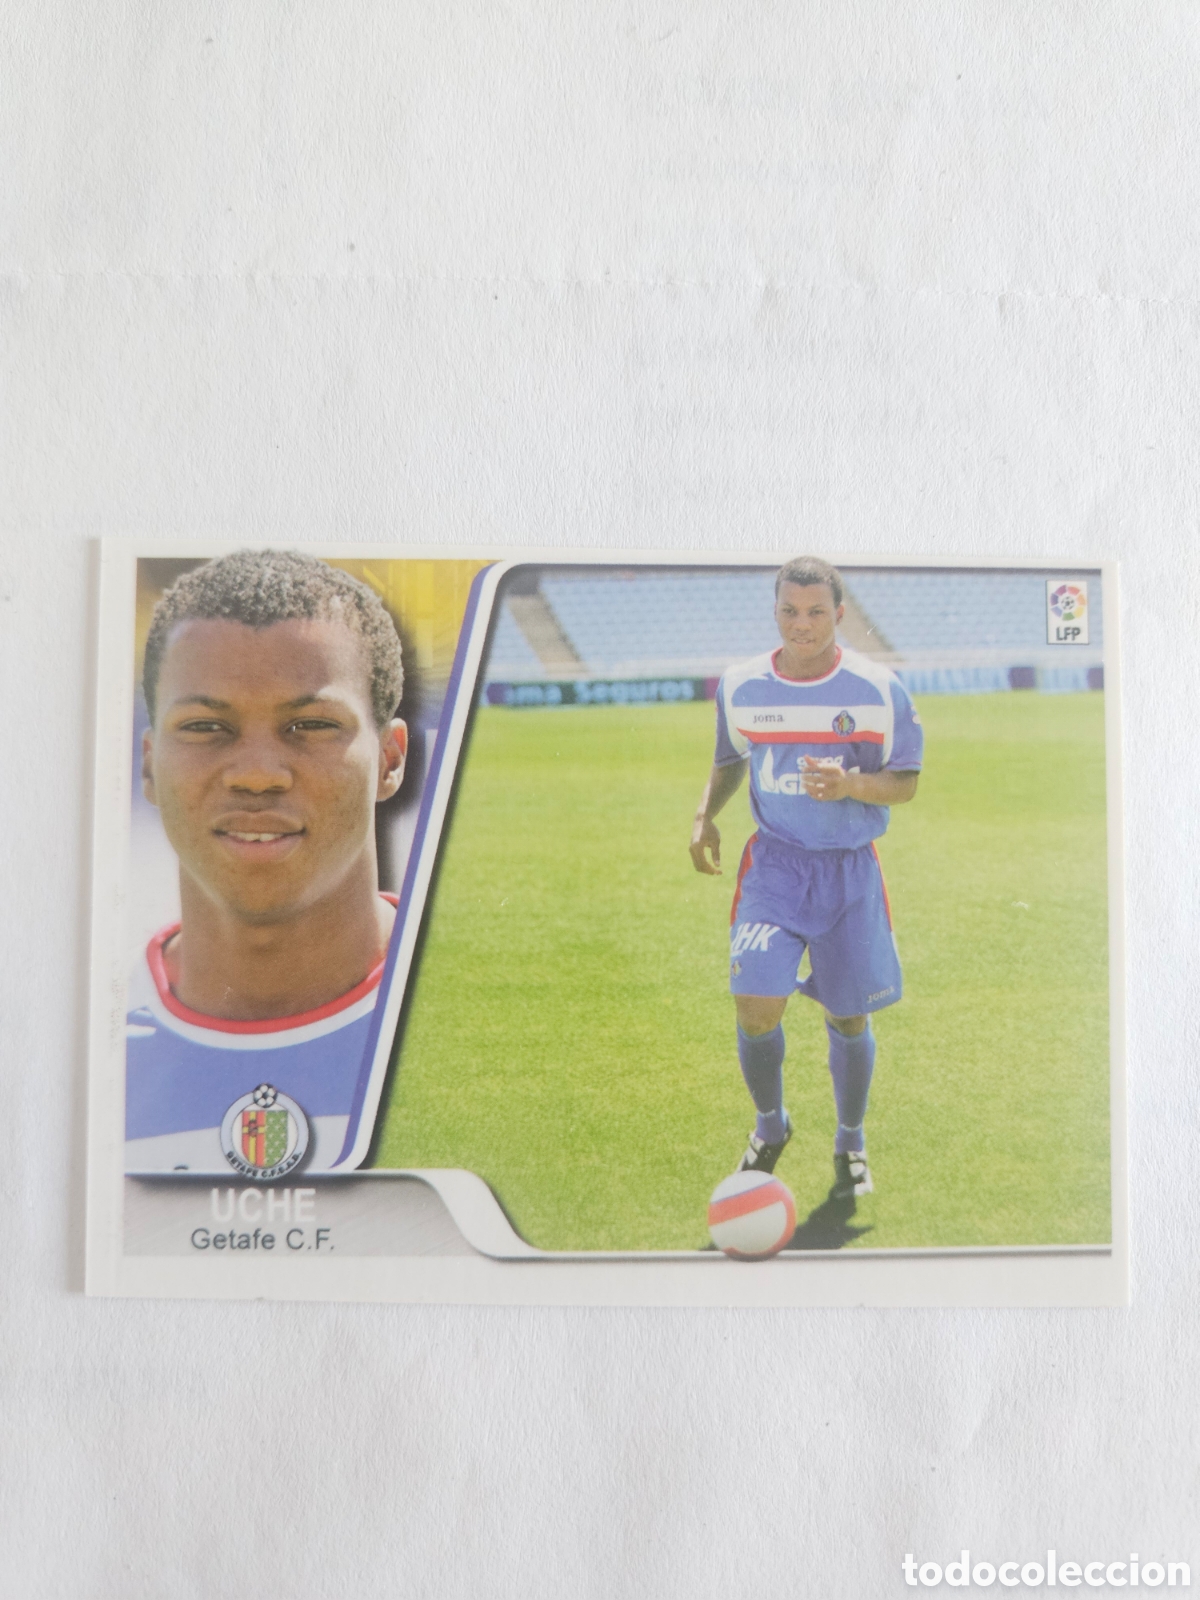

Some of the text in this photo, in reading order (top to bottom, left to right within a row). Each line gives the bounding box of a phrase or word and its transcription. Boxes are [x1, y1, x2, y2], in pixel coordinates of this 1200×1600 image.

[1056, 627, 1081, 641] LFP
[210, 1187, 316, 1223] UCHE
[190, 1228, 335, 1251] Getafe C.F.
